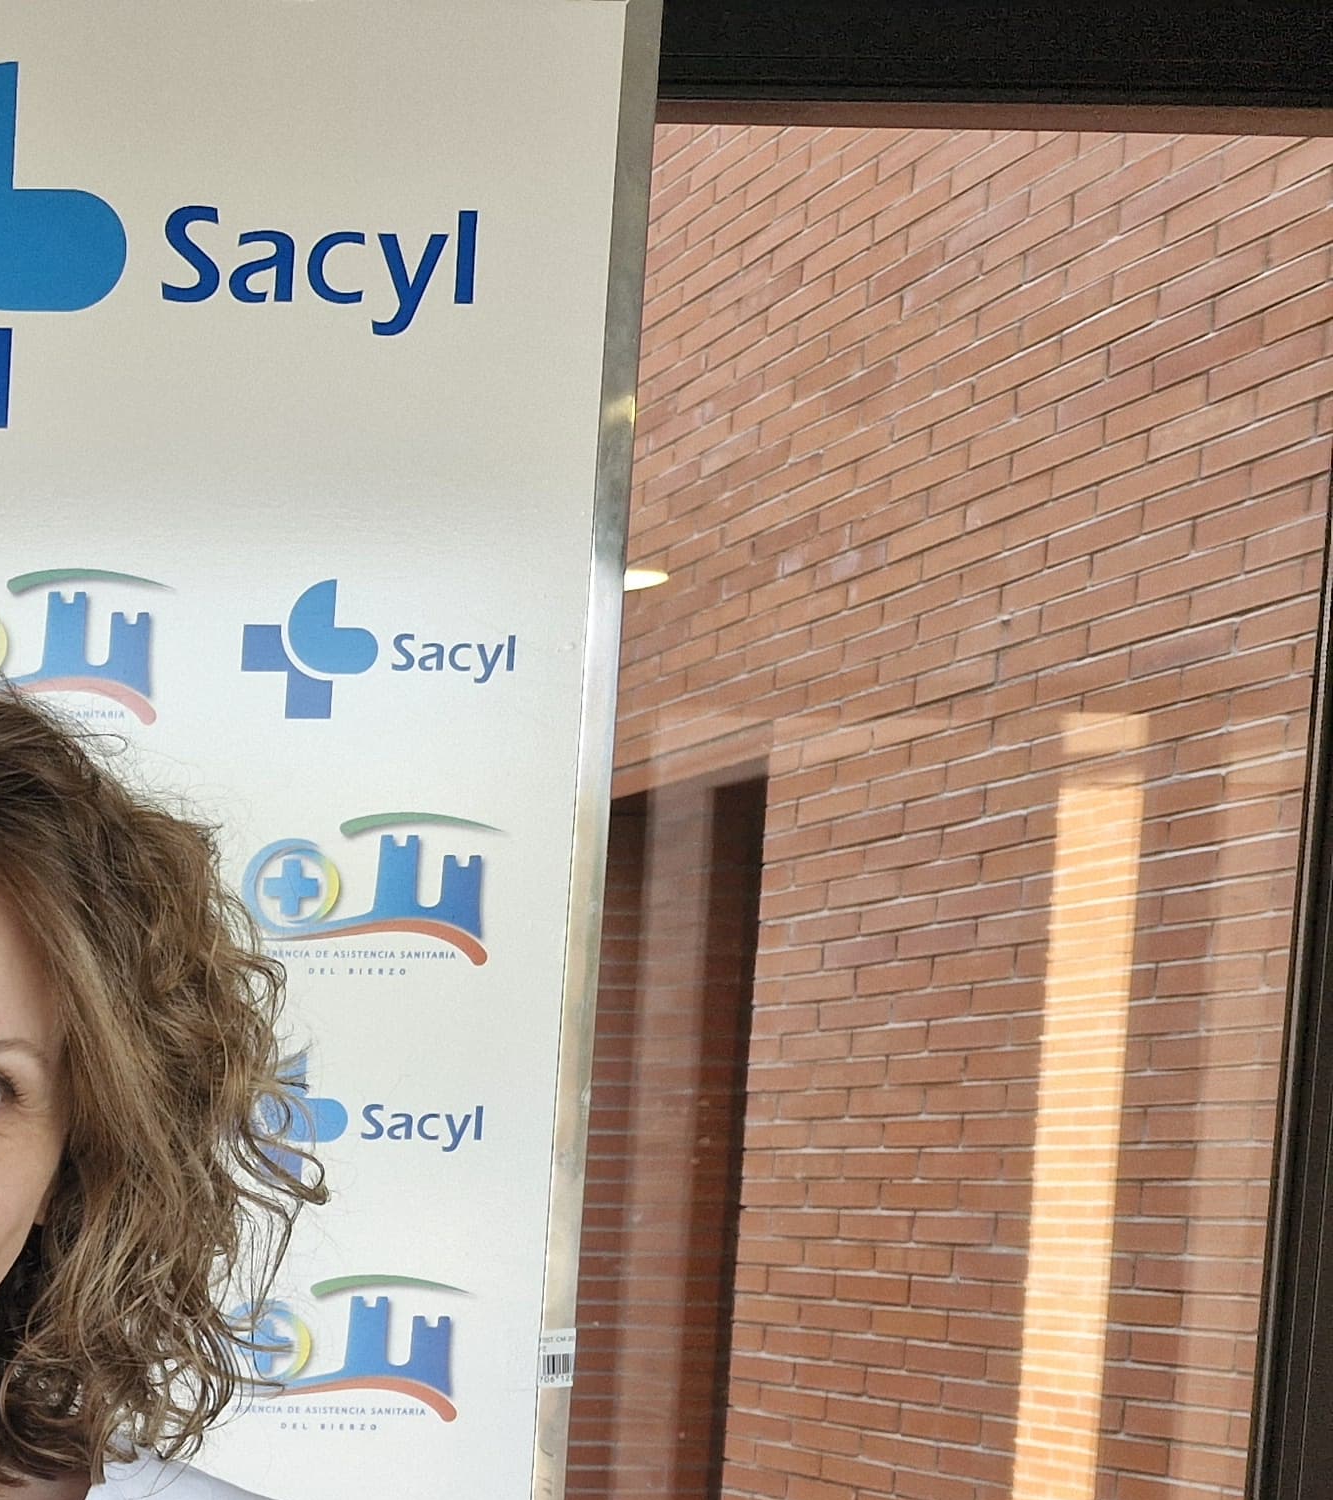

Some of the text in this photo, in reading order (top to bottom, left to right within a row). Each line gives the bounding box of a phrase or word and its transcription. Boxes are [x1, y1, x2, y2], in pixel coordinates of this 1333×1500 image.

[160, 204, 479, 337] Sacyl
[391, 632, 516, 684] Sacyl
[360, 1103, 484, 1152] Sacyl
